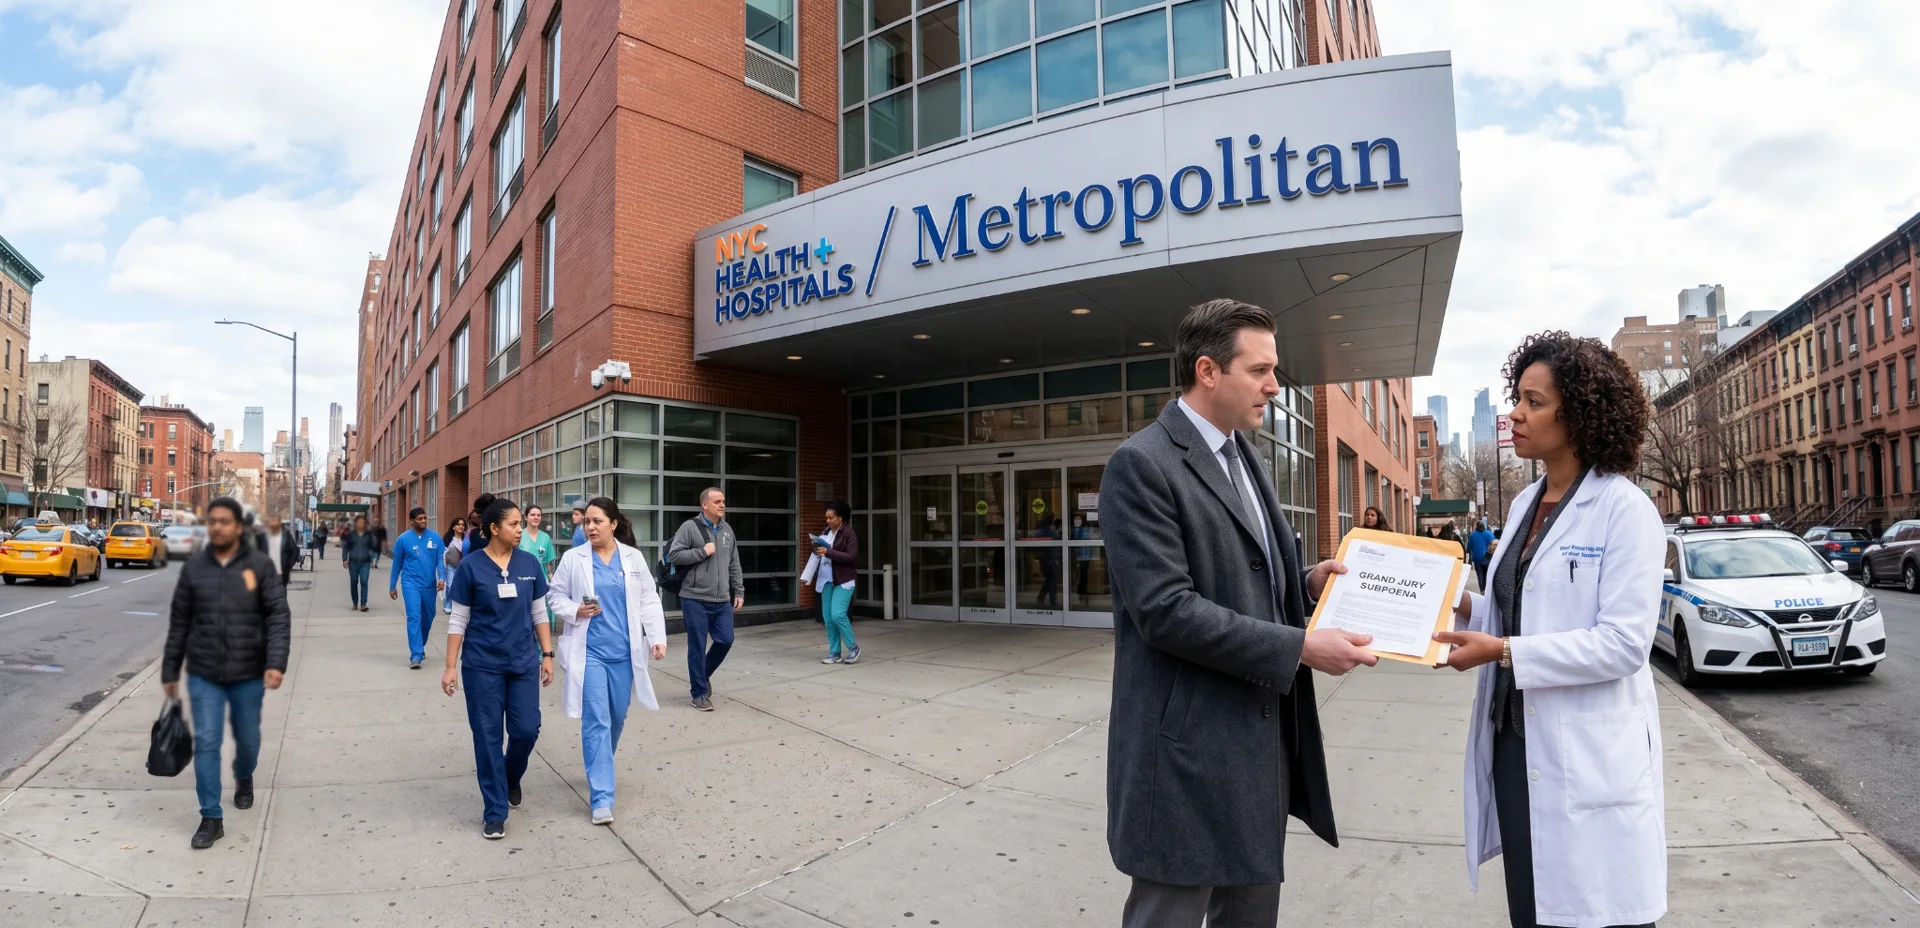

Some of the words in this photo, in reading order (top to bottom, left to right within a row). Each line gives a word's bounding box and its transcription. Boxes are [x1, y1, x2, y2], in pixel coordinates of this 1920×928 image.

[911, 132, 1410, 269] Metropolitan
[715, 223, 768, 264] NYC
[715, 263, 856, 324] HOSPITALS
[1359, 571, 1396, 584] GRAND
[1397, 578, 1426, 590] JURY
[1359, 582, 1417, 599] SUBPOENA
[1774, 597, 1825, 608] POLICE
